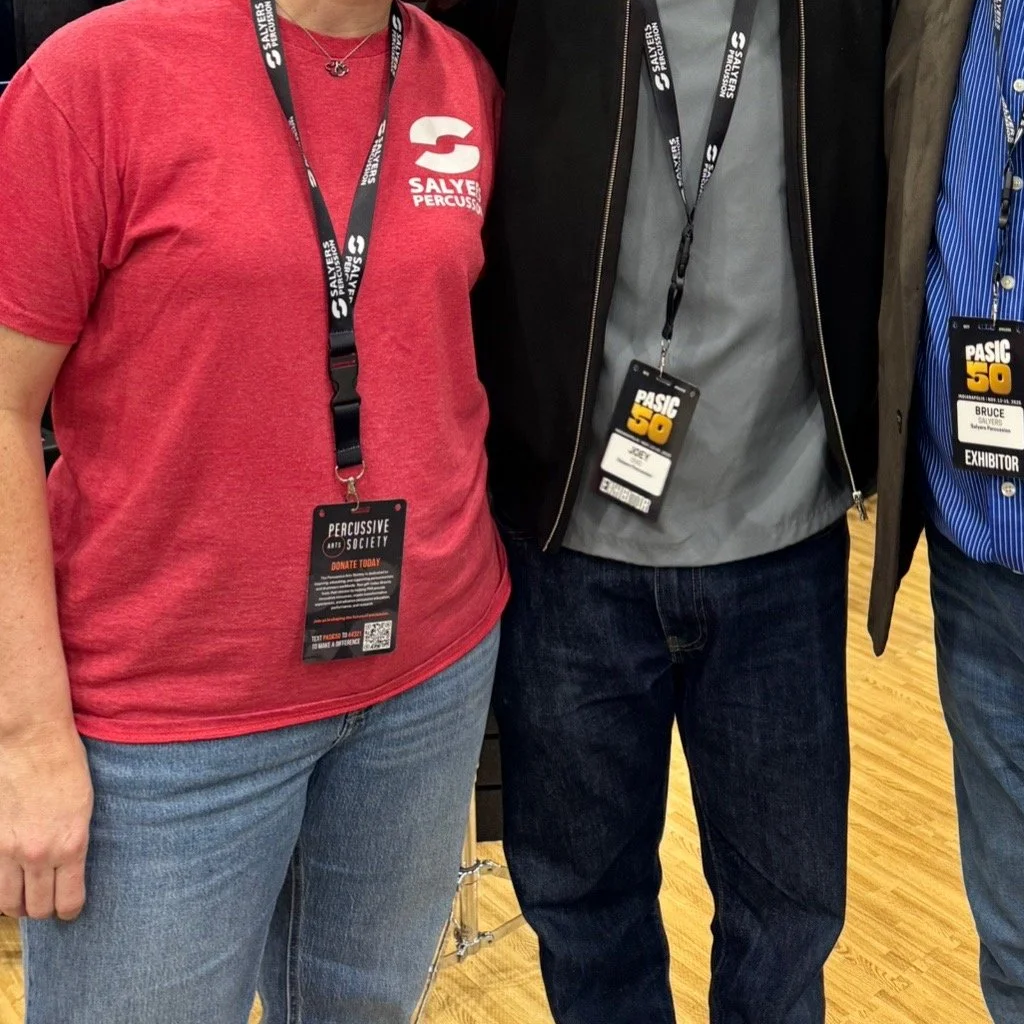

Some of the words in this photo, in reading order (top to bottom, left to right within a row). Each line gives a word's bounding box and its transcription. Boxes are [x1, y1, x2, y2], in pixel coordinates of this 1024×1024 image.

[255, 2, 272, 50] SALYERS
[264, 0, 279, 47] PERCUSSION
[644, 24, 661, 73] SALYERS
[651, 22, 668, 71] PERCUSSION
[719, 48, 736, 98] PERCUSSION
[726, 50, 744, 100] SALYERS
[322, 241, 338, 298] SALYERS
[328, 239, 345, 296] PERCUSSION
[964, 339, 1011, 364] PASIC
[966, 360, 1012, 396] 50
[626, 403, 673, 446] 50
[634, 389, 681, 419] PASIC
[975, 406, 1005, 418] BRUCE
[964, 448, 1020, 473] EXHIBITOR
[328, 518, 390, 537] PERCUSSIVE
[346, 535, 388, 551] SOCIETY
[331, 559, 358, 571] DONATE
[359, 557, 381, 568] TODAY
